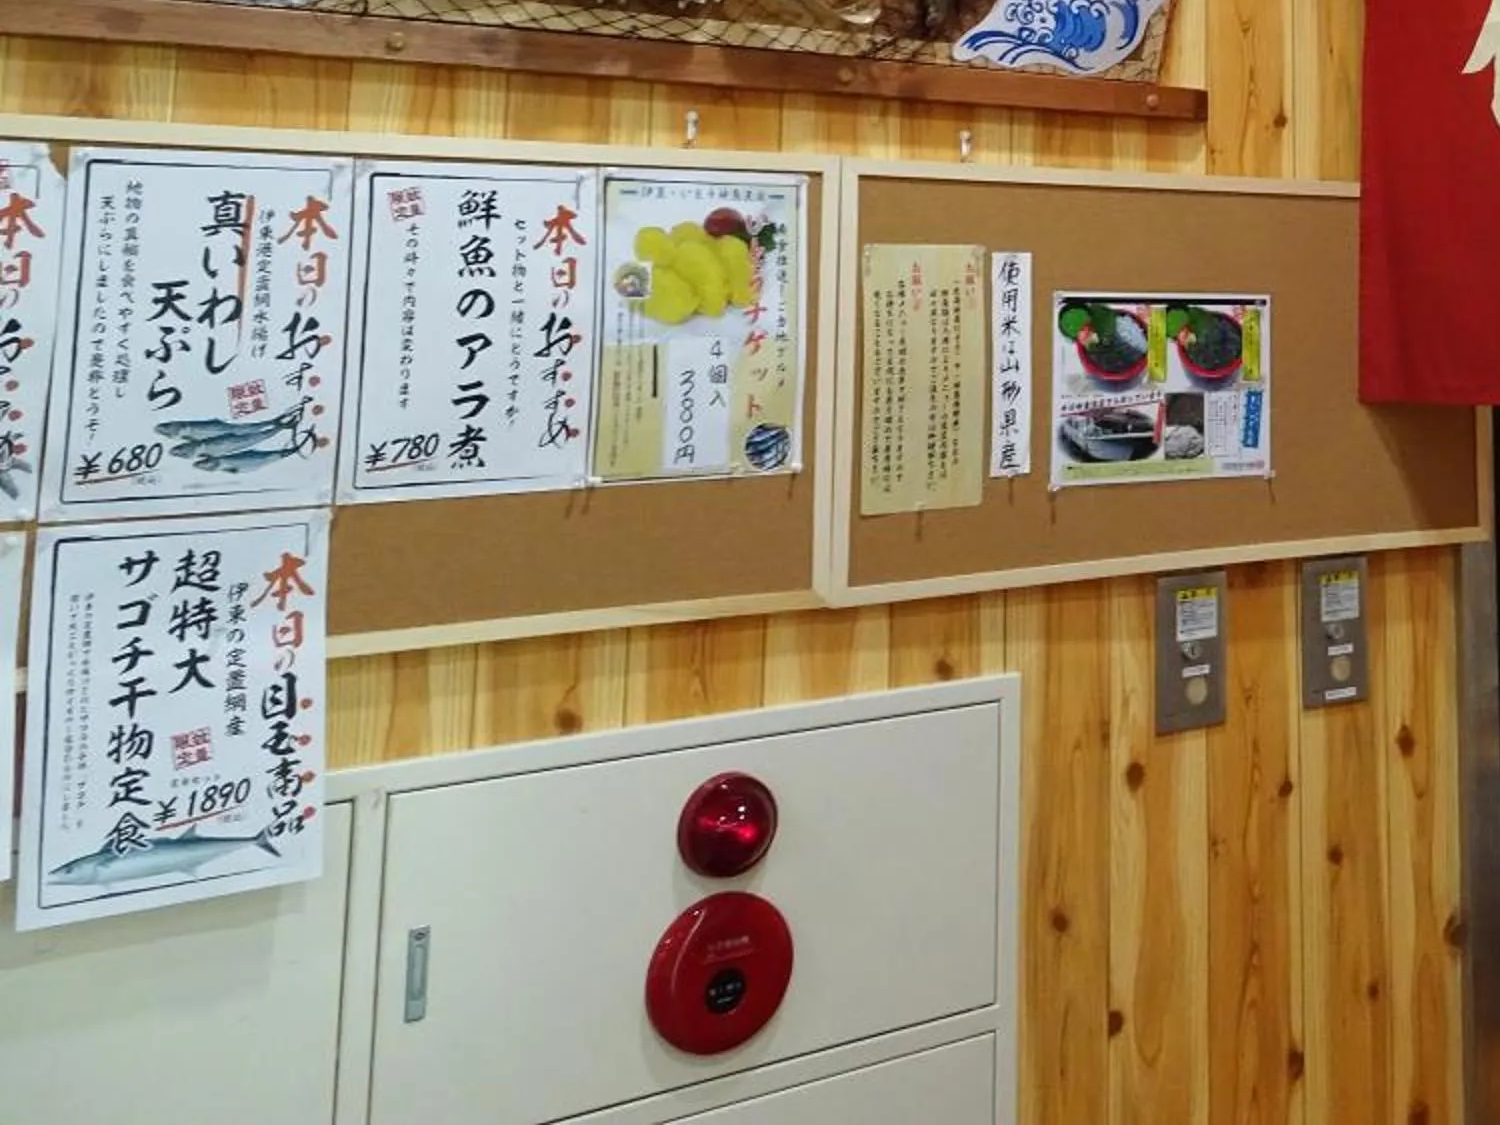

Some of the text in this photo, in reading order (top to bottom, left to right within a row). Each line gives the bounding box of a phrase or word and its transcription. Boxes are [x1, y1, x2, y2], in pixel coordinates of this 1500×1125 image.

[145, 278, 194, 412] 天ぷら
[199, 190, 247, 375] 真いわし
[275, 195, 339, 461] 本日のおすすめ
[447, 189, 503, 470] 鮮魚のアラ煮
[532, 204, 588, 450] 本日のおすすめ
[72, 442, 165, 480] ¥680
[364, 432, 441, 468] ¥780
[104, 549, 162, 855] サゴチ干物定食
[166, 547, 222, 695] 超特大
[152, 777, 252, 824] ¥1890
